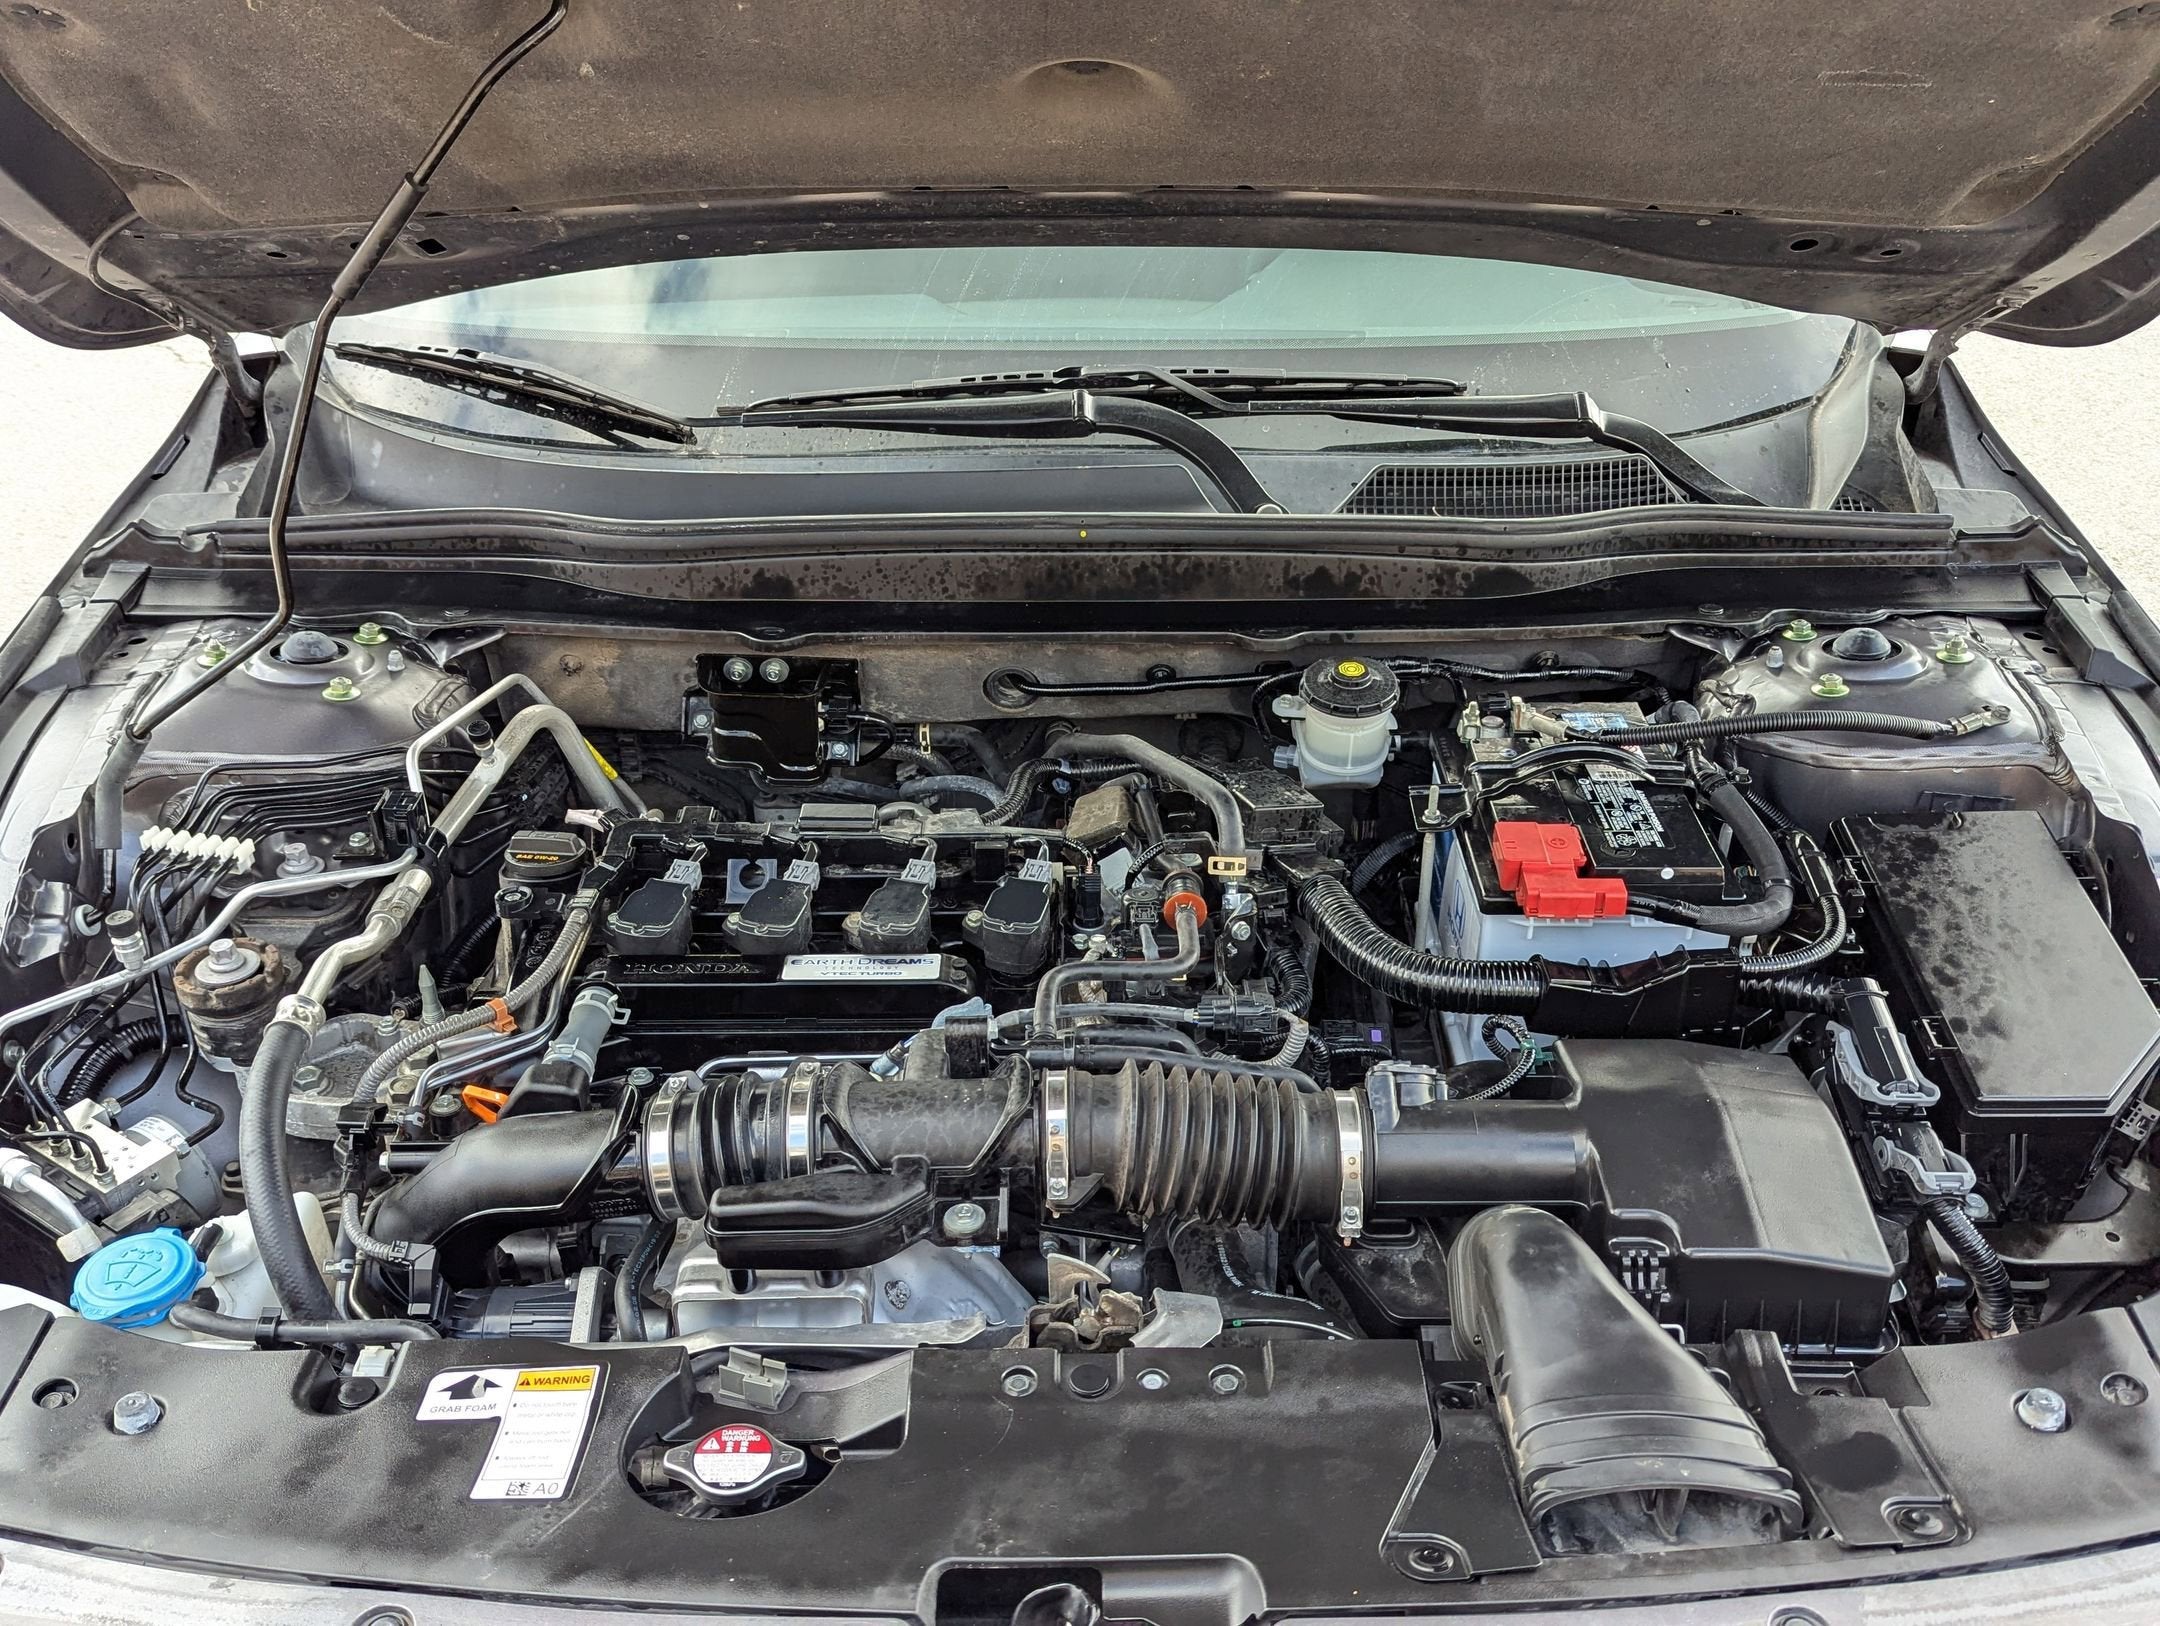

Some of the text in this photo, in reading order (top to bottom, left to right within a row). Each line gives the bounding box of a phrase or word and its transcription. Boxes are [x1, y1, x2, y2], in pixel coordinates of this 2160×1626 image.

[790, 957, 935, 966] EARTH DREAMS
[623, 962, 761, 975] HONDA
[533, 1375, 591, 1386] WARNING
[430, 1403, 497, 1413] GRAB FOAM
[533, 1482, 559, 1495] A0
